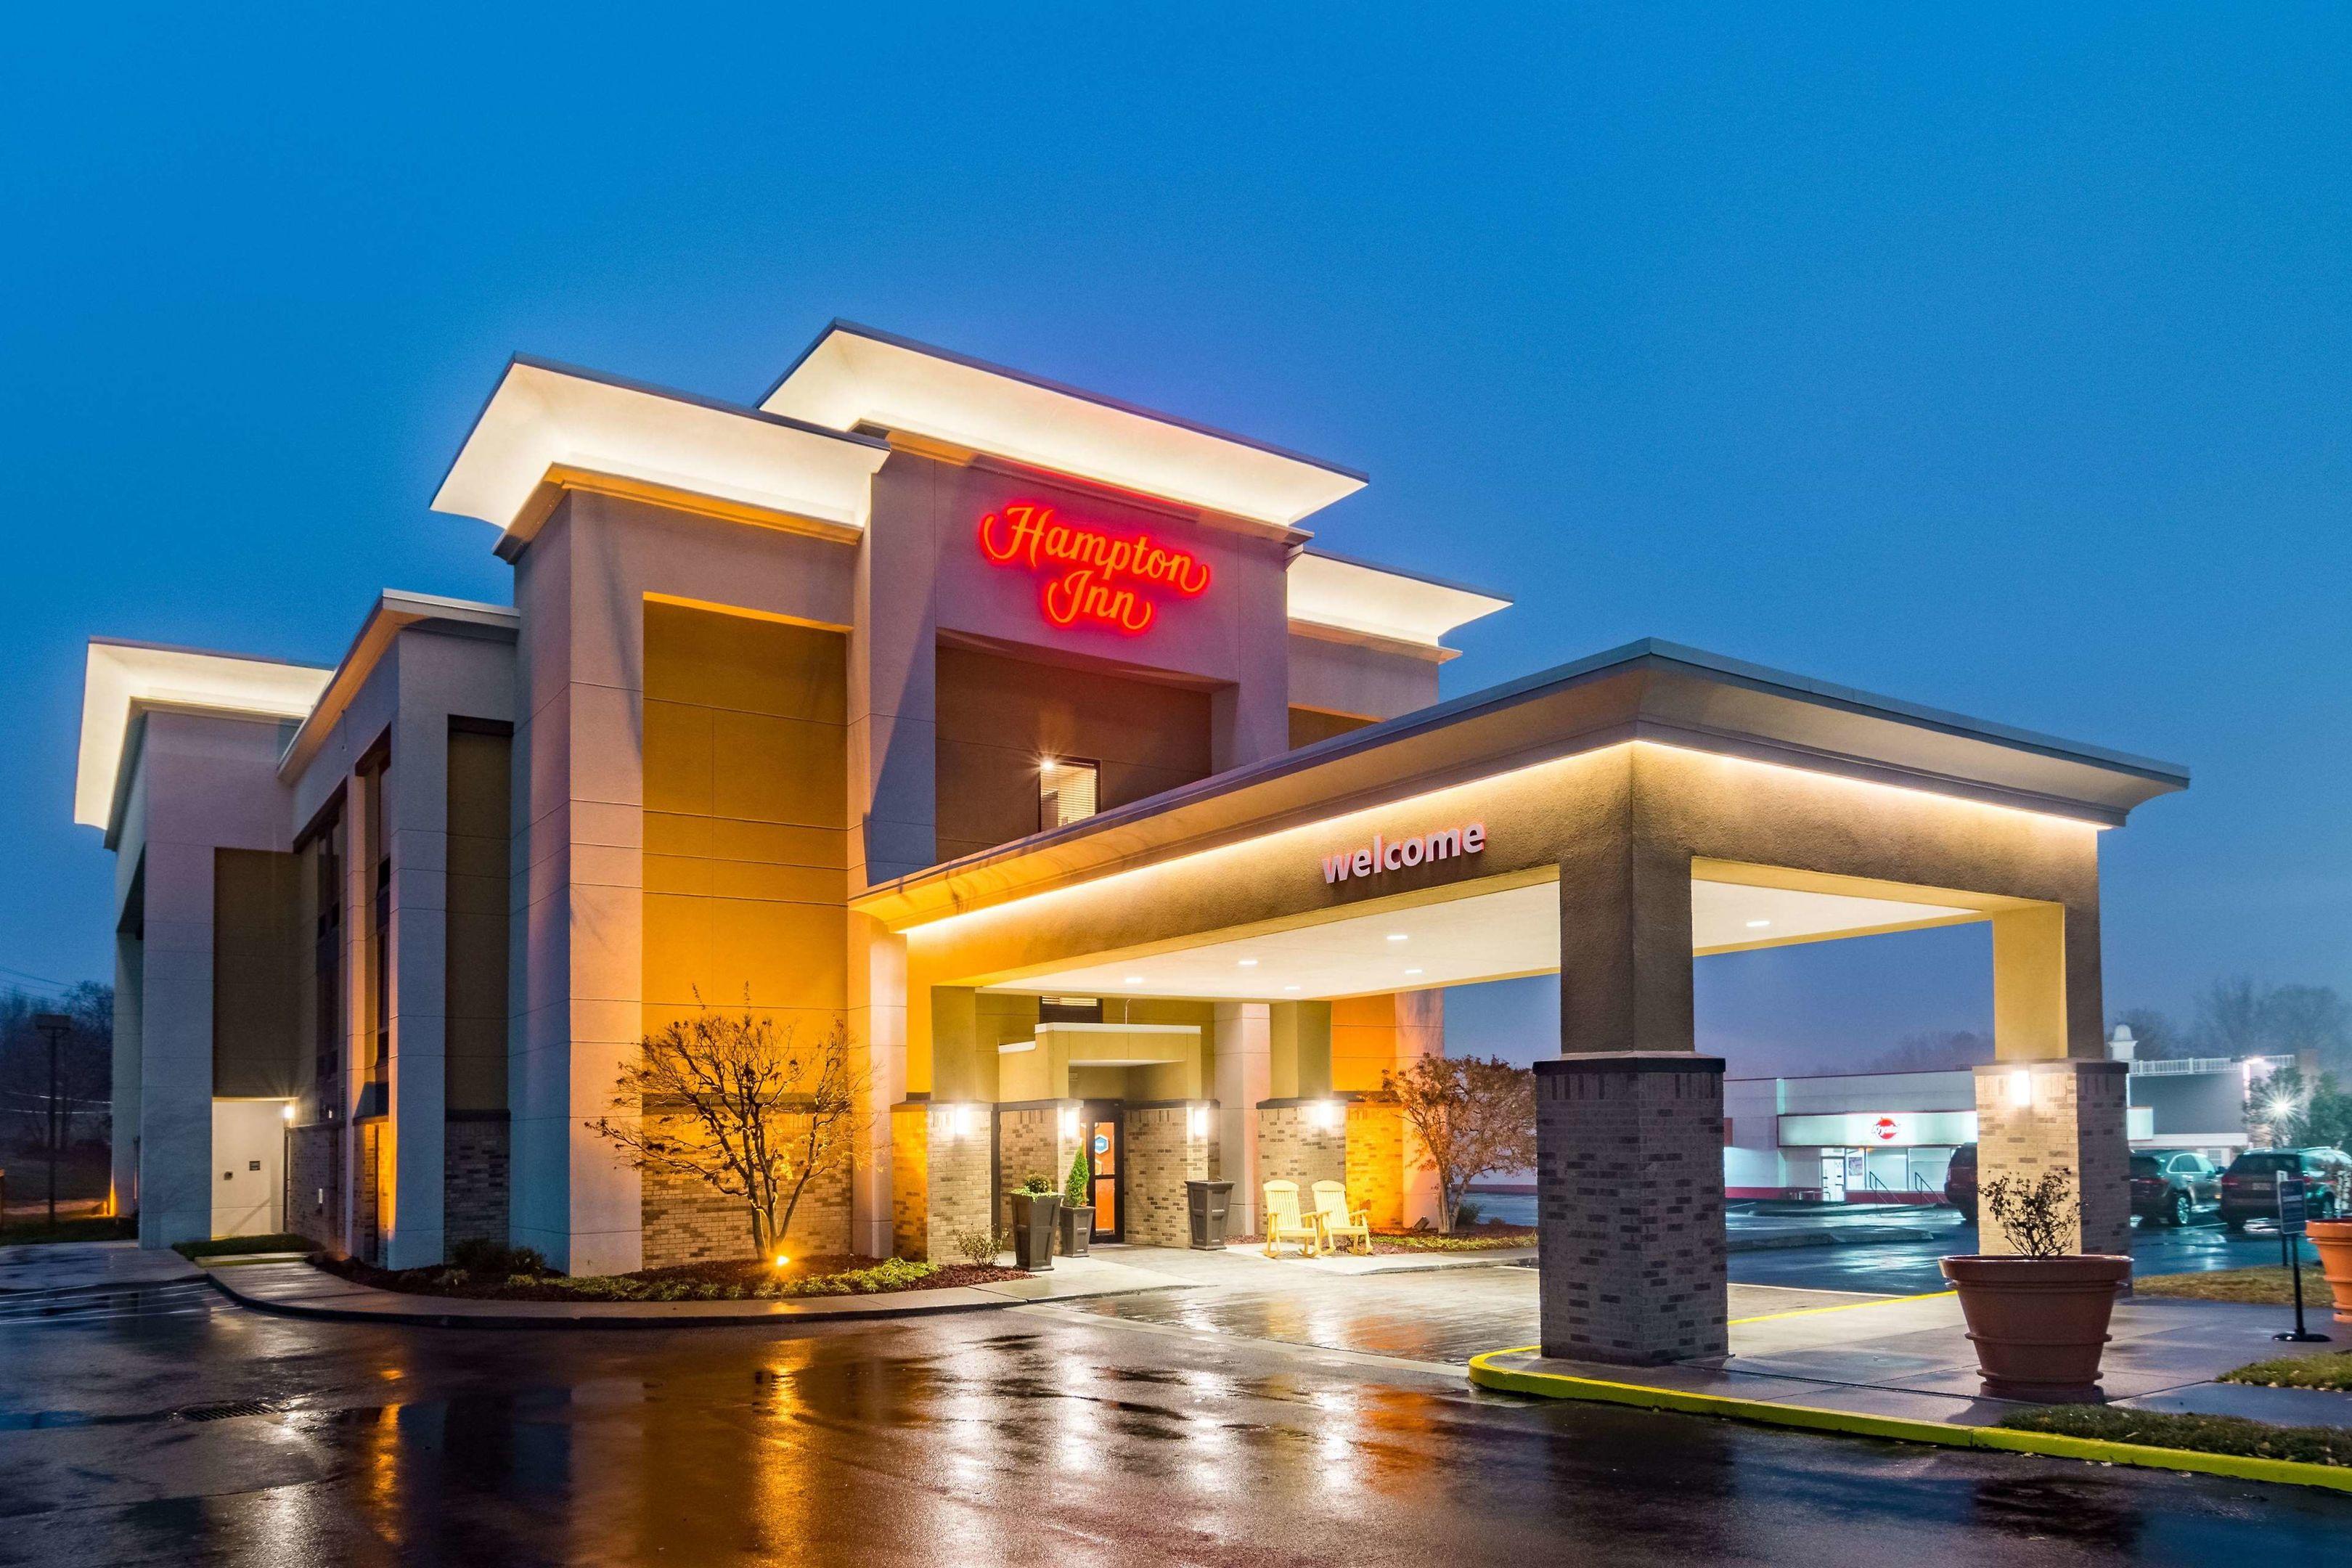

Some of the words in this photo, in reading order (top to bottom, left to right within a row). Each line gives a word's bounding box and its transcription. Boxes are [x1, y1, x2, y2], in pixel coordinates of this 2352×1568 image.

[984, 507, 1206, 592] Hampton
[1048, 570, 1151, 629] Inn
[1322, 822, 1486, 883] welcome
